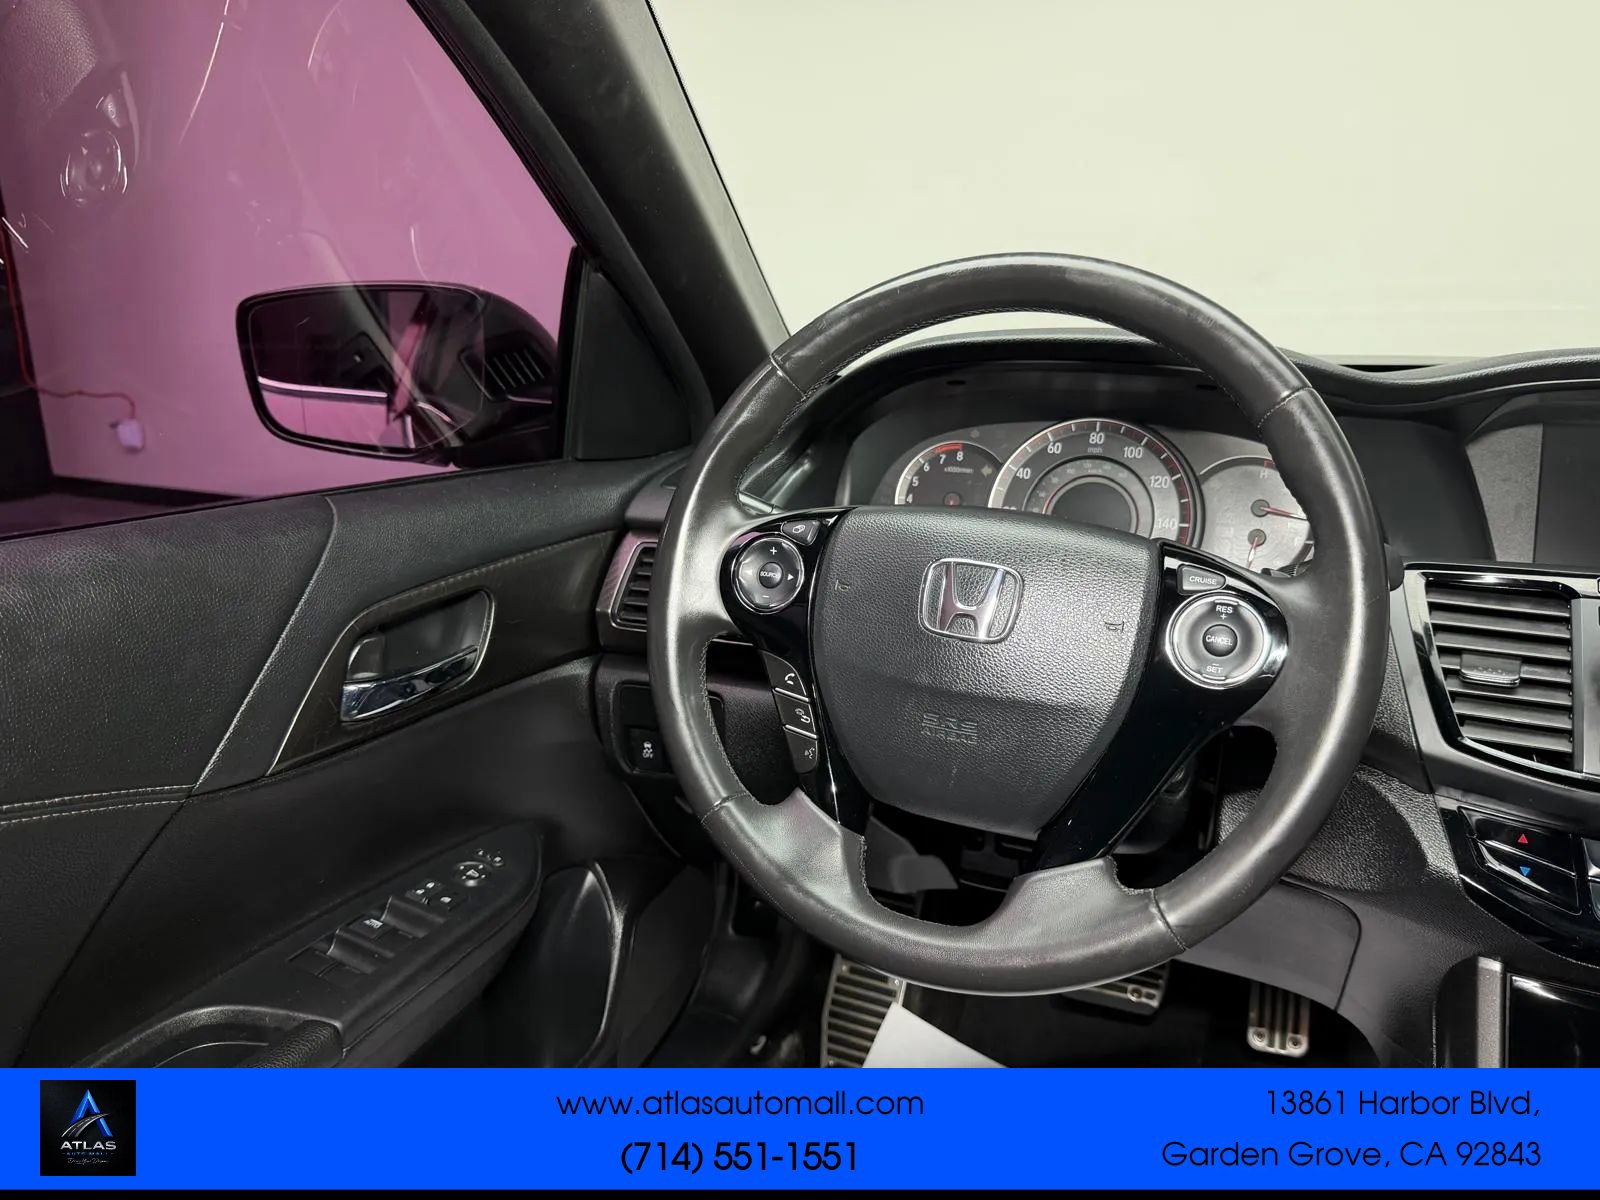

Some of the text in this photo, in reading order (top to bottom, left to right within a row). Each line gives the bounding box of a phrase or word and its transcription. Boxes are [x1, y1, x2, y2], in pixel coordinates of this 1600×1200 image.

[1088, 432, 1104, 445] 80
[1047, 442, 1062, 454] 60
[1123, 446, 1143, 459] 100
[939, 454, 946, 464] 7
[956, 451, 963, 461] 8
[923, 462, 930, 472] 6
[1016, 467, 1031, 479] 40
[912, 476, 919, 487] 5
[1150, 475, 1169, 489] 120
[1157, 518, 1178, 530] 140
[1189, 576, 1217, 585] CRUISE
[1215, 605, 1233, 613] RES
[1205, 635, 1233, 646] CANCEL
[1206, 665, 1223, 674] SET
